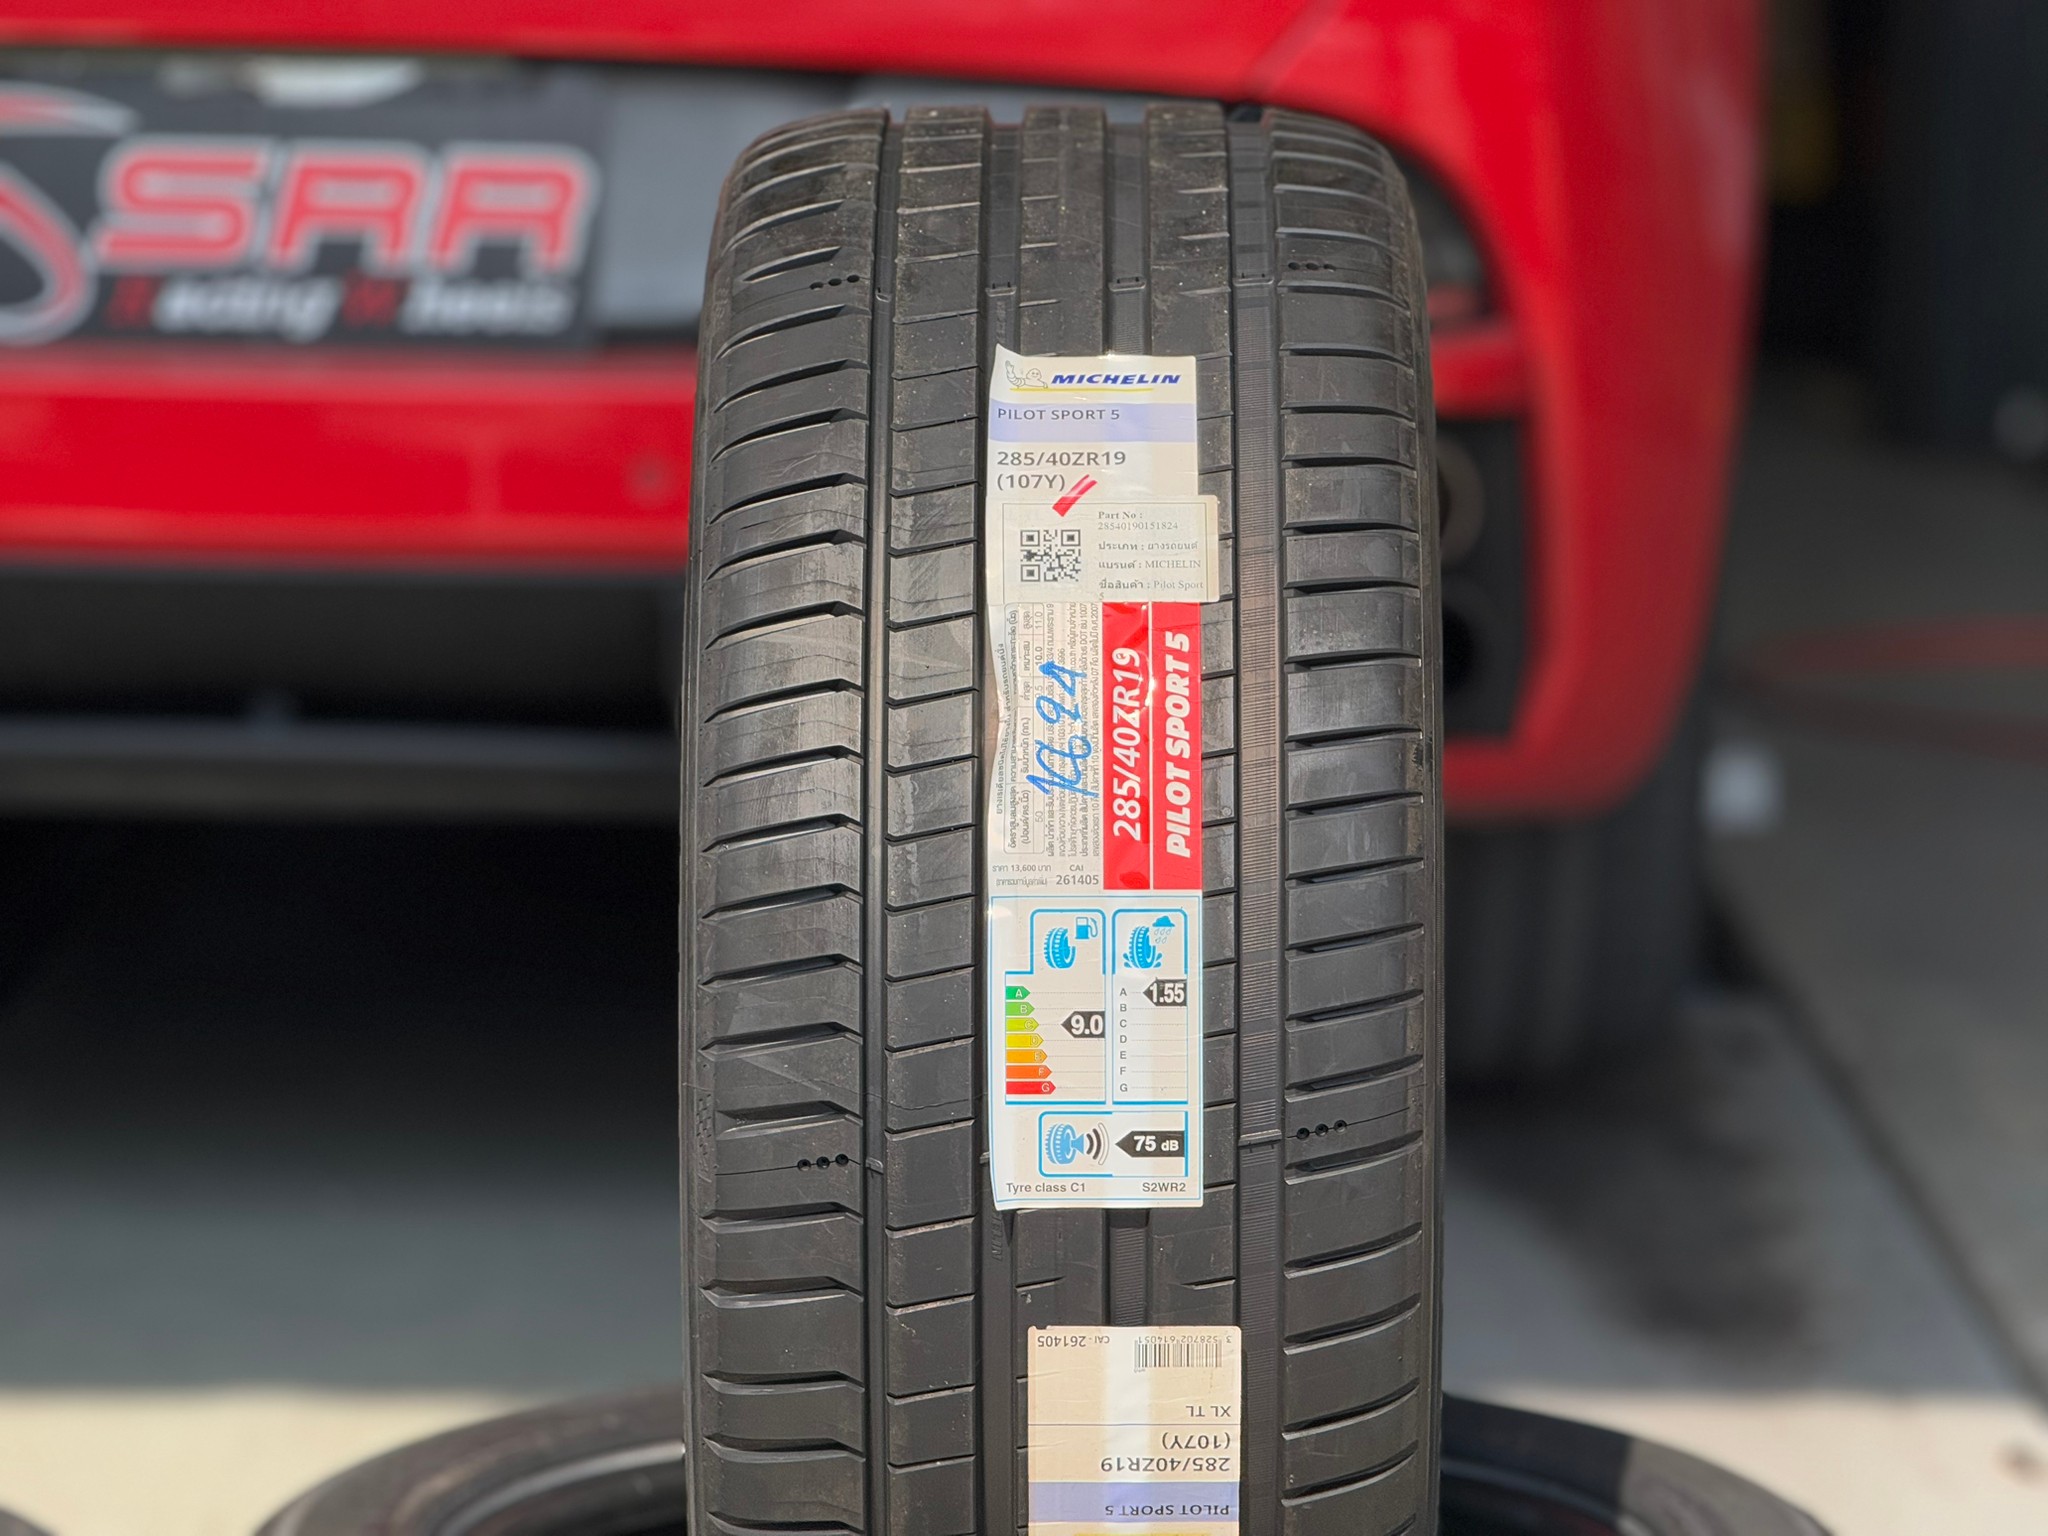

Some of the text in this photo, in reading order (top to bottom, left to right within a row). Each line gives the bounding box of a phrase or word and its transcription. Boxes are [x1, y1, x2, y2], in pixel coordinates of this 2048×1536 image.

[1051, 374, 1182, 384] MICHELIN
[997, 408, 1120, 420] PILOT SPORT 5
[996, 451, 1127, 466] 285/40ZR19
[996, 474, 1066, 491] (107Y)
[1098, 511, 1119, 519] Part
[1122, 511, 1137, 519] No
[1145, 559, 1202, 569] MICHELIN
[1153, 580, 1176, 590] Pilot
[1177, 580, 1204, 592] Sport
[1112, 647, 1141, 842] 285/40ZR19
[1165, 631, 1192, 858] PILOT SPORT 5
[1010, 864, 1037, 873] 13,600
[1069, 864, 1084, 872] CAI
[1055, 874, 1099, 886] 261405
[1015, 988, 1023, 998] A
[1119, 988, 1127, 997] A
[1149, 982, 1185, 1003] 1.55
[1120, 1004, 1127, 1013] B
[1070, 1015, 1103, 1035] 9.0
[1119, 1019, 1127, 1028] C
[1120, 1035, 1127, 1044] D
[1120, 1051, 1127, 1060] E
[1120, 1067, 1126, 1076] F
[1041, 1083, 1050, 1093] G
[1119, 1083, 1128, 1093] G
[1133, 1135, 1180, 1152] 75 dB
[1006, 1181, 1086, 1195] Tyre class C1
[1142, 1181, 1187, 1193] S2WR2
[1037, 1335, 1087, 1348] 261405
[1094, 1335, 1110, 1344] CAI
[1137, 1335, 1232, 1344] 3 528702 614051
[1185, 1406, 1232, 1418] XL TL
[1161, 1431, 1231, 1450] (107Y)
[1100, 1457, 1231, 1473] 285/40ZR19
[1105, 1504, 1230, 1516] PILOT SPORT 5
